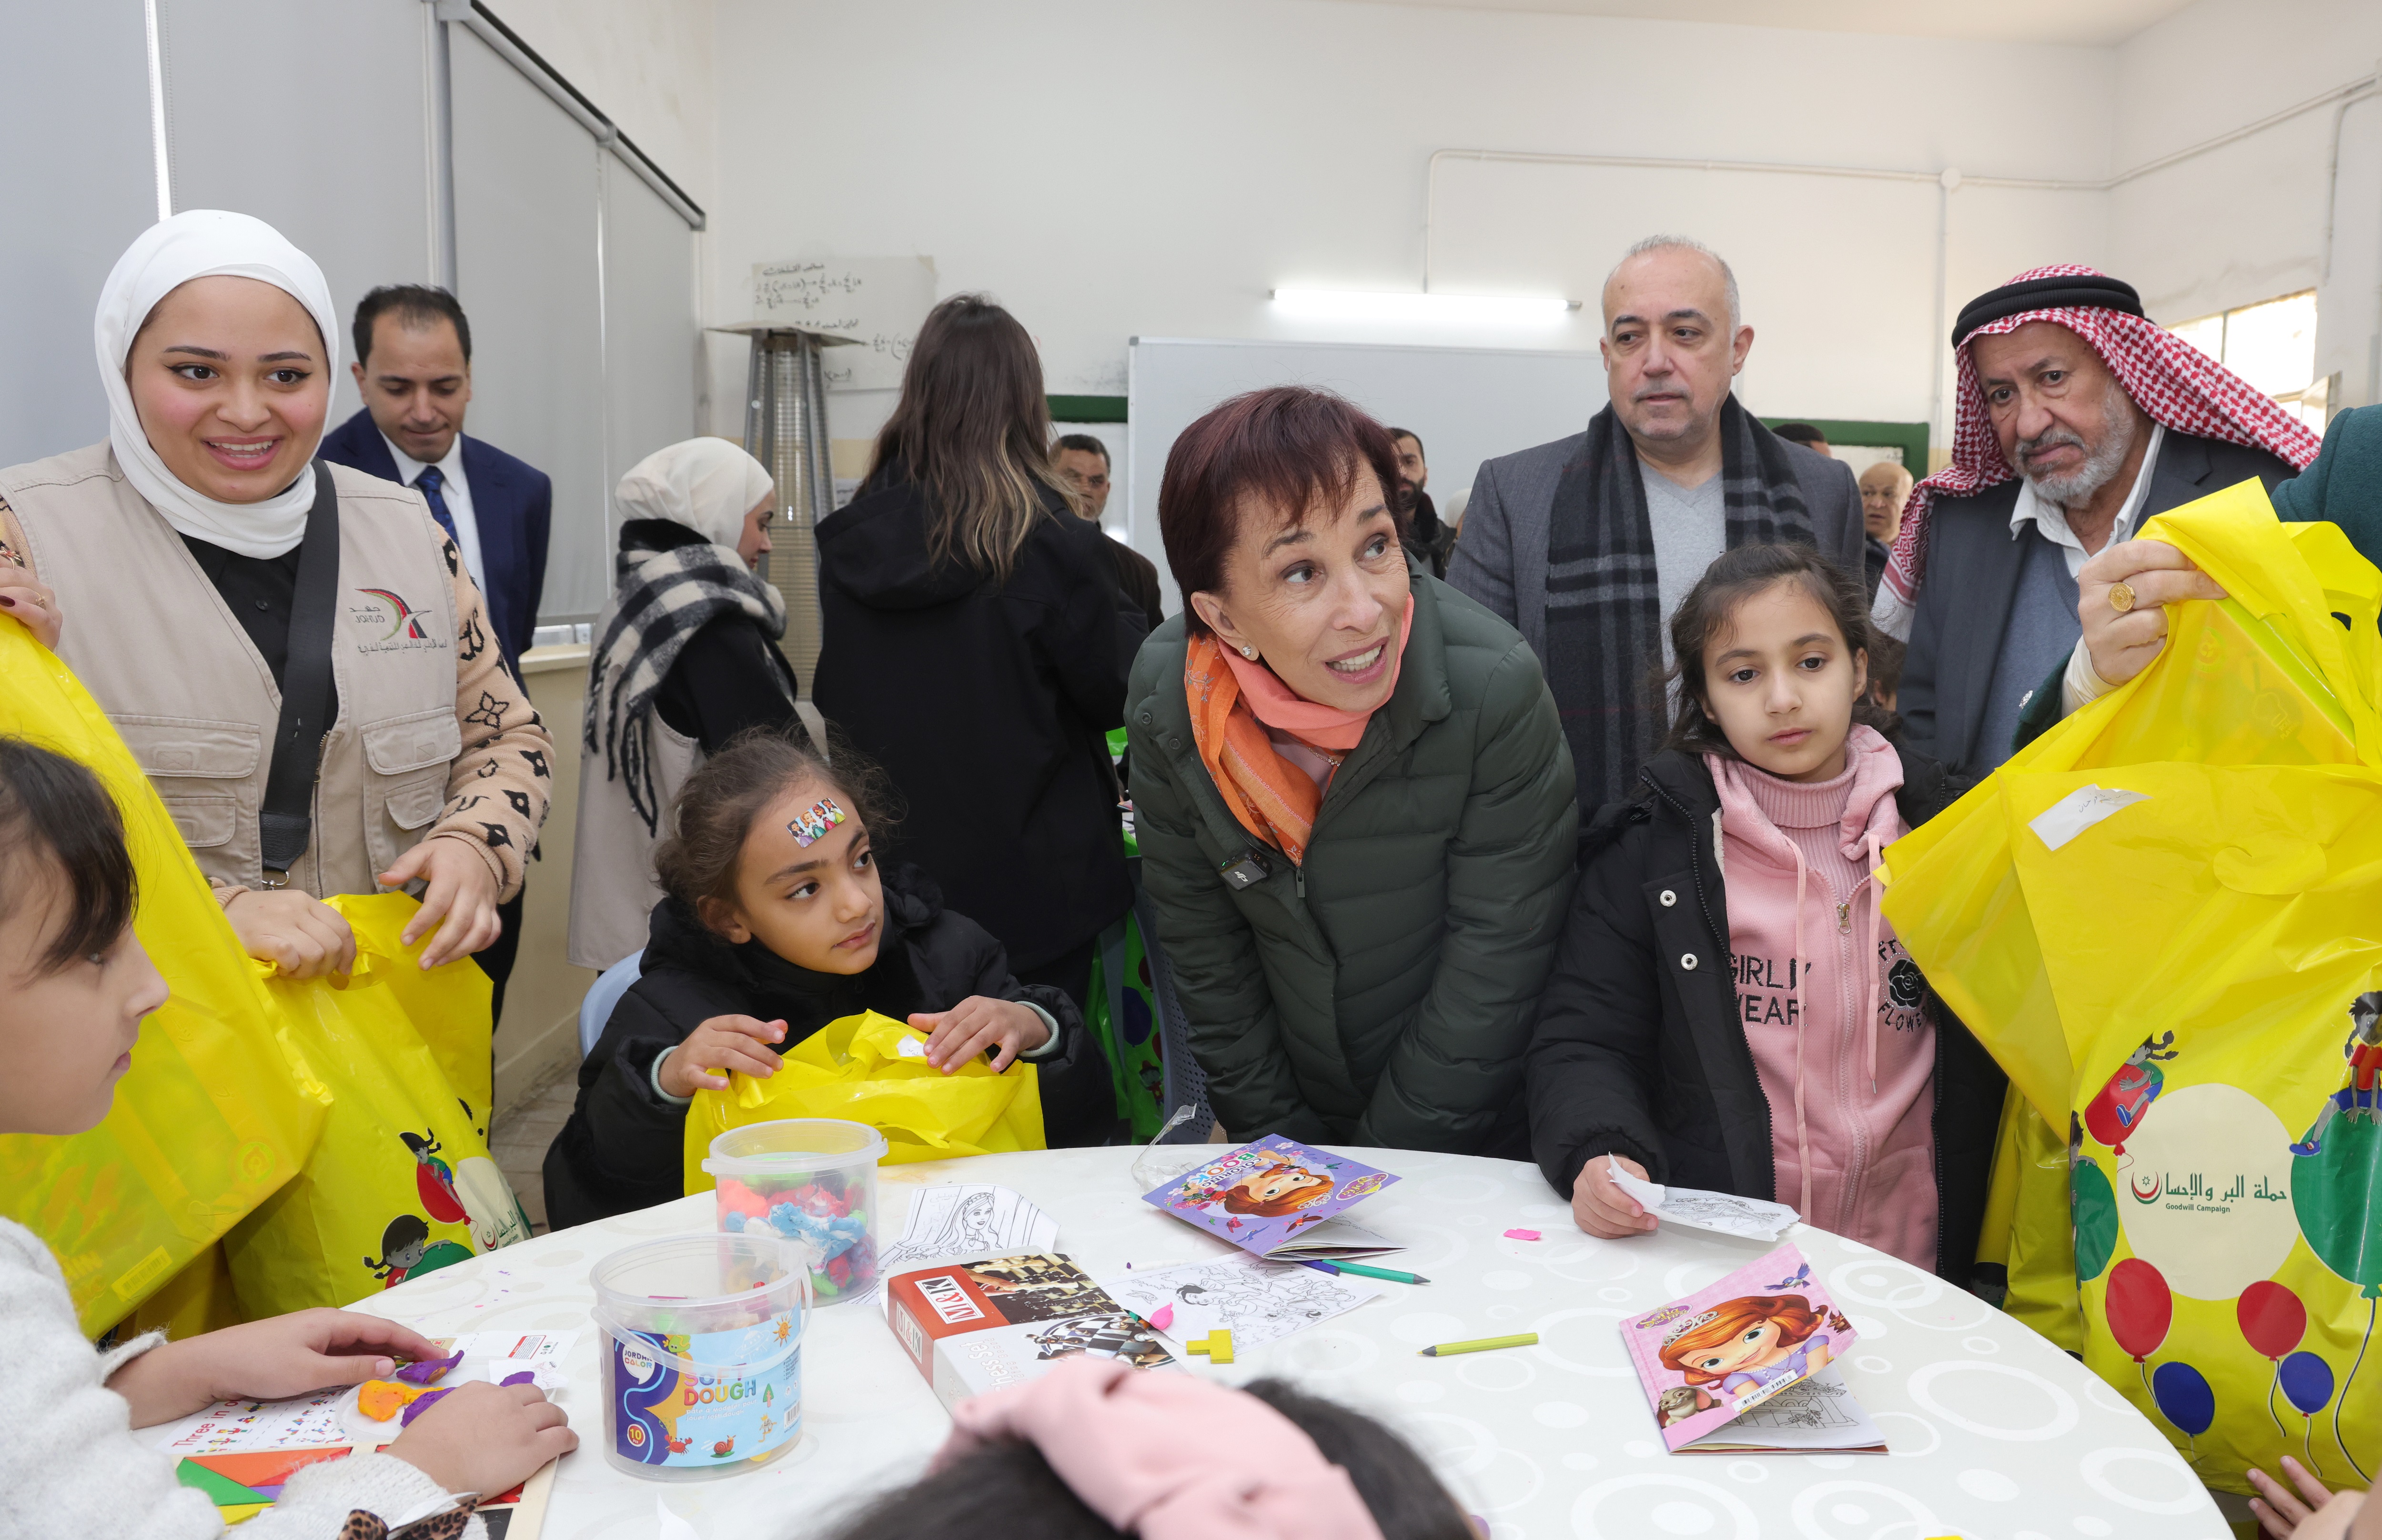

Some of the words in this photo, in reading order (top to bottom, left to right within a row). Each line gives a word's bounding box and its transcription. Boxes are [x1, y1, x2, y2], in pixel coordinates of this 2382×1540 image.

[1190, 1153, 1256, 1184] BOOK
[1201, 1158, 1262, 1187] COLORING
[2220, 1174, 2244, 1203] البر
[2254, 1174, 2287, 1202] حملة
[2166, 1203, 2194, 1211] Goodwill
[2197, 1205, 2231, 1213] Campaign
[1665, 1309, 1688, 1322] First
[981, 1359, 1016, 1391] hess
[684, 1379, 756, 1406] DOUGH
[172, 1423, 216, 1447] Three
[205, 1410, 230, 1419] in
[224, 1399, 242, 1407] o
[629, 1428, 642, 1440] 10
